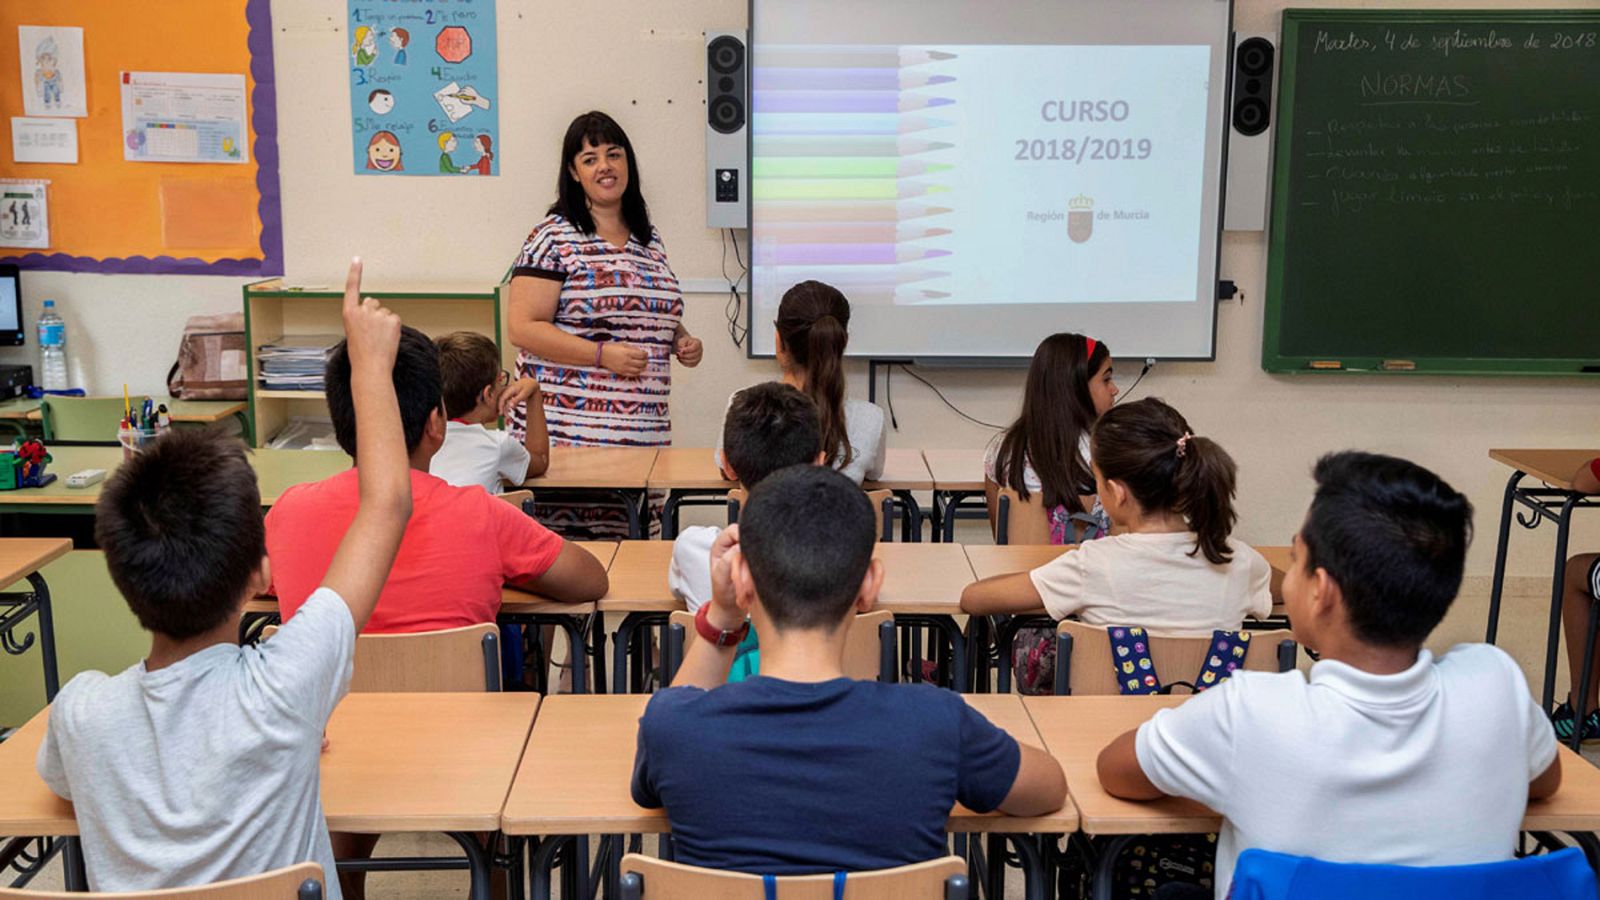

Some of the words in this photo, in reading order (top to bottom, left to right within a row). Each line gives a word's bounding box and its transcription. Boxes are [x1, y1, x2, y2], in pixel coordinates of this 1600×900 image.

[1384, 28, 1396, 51] 4
[1400, 33, 1421, 50] de
[1432, 28, 1513, 56] septiembre
[1523, 32, 1540, 49] de
[1549, 31, 1597, 49] 2018
[1360, 69, 1470, 97] NORMAS
[1041, 99, 1130, 122] CURSO
[1014, 136, 1153, 165] 2018/2019
[1027, 210, 1064, 223] Región
[1096, 210, 1111, 221] de
[1113, 209, 1150, 221] Murcia
